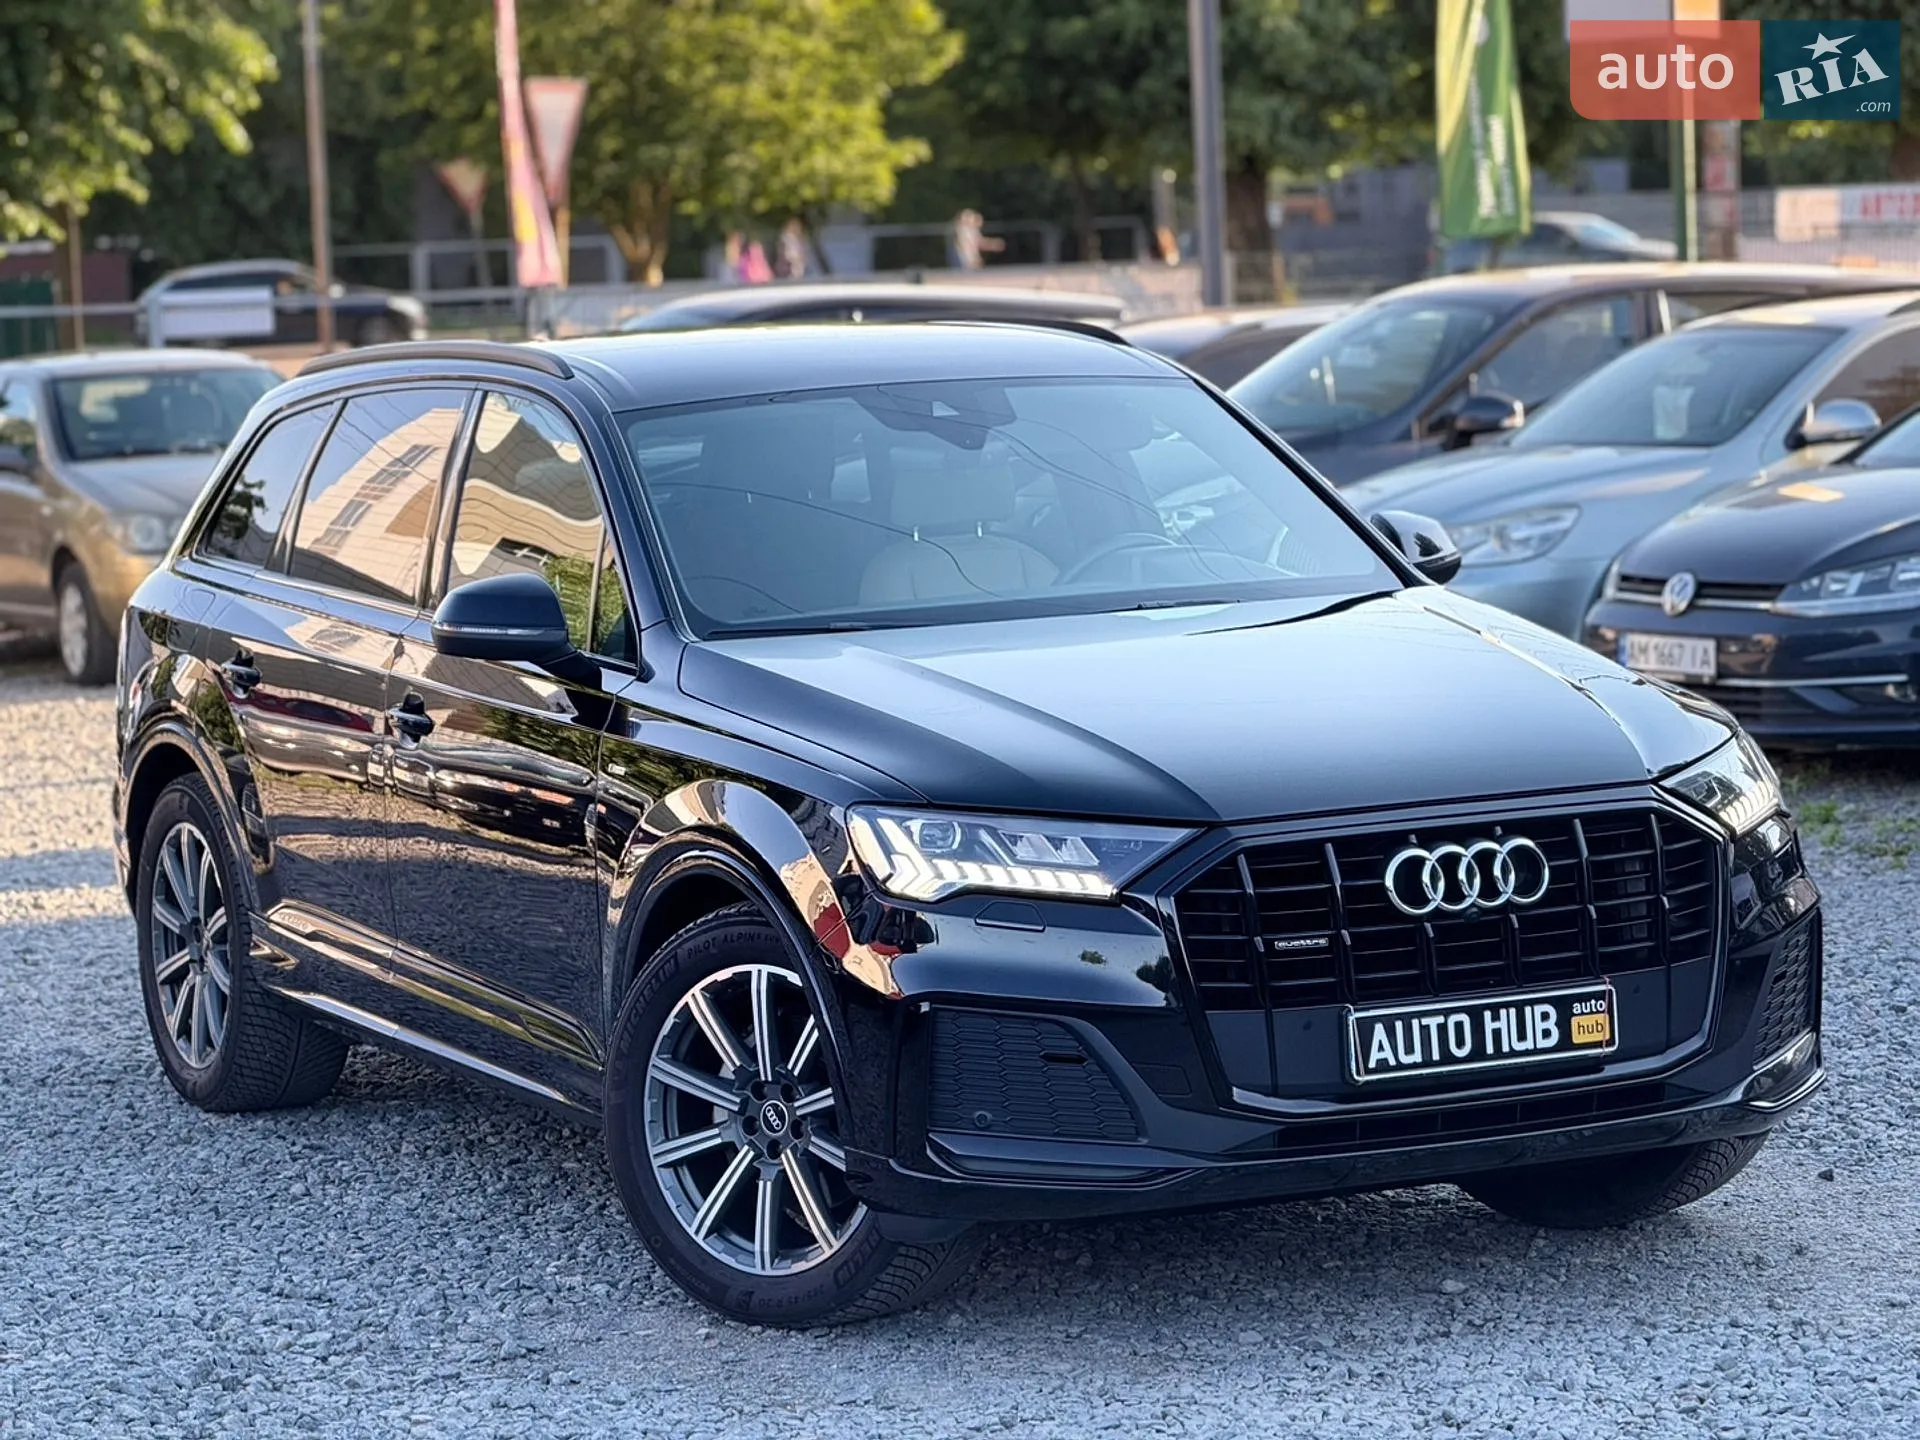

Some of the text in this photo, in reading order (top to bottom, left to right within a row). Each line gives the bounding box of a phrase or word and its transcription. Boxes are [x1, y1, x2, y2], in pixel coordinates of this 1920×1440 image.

[1572, 999, 1607, 1015] auto
[1368, 1003, 1560, 1069] AUTO HUB
[1577, 1019, 1605, 1036] hub
